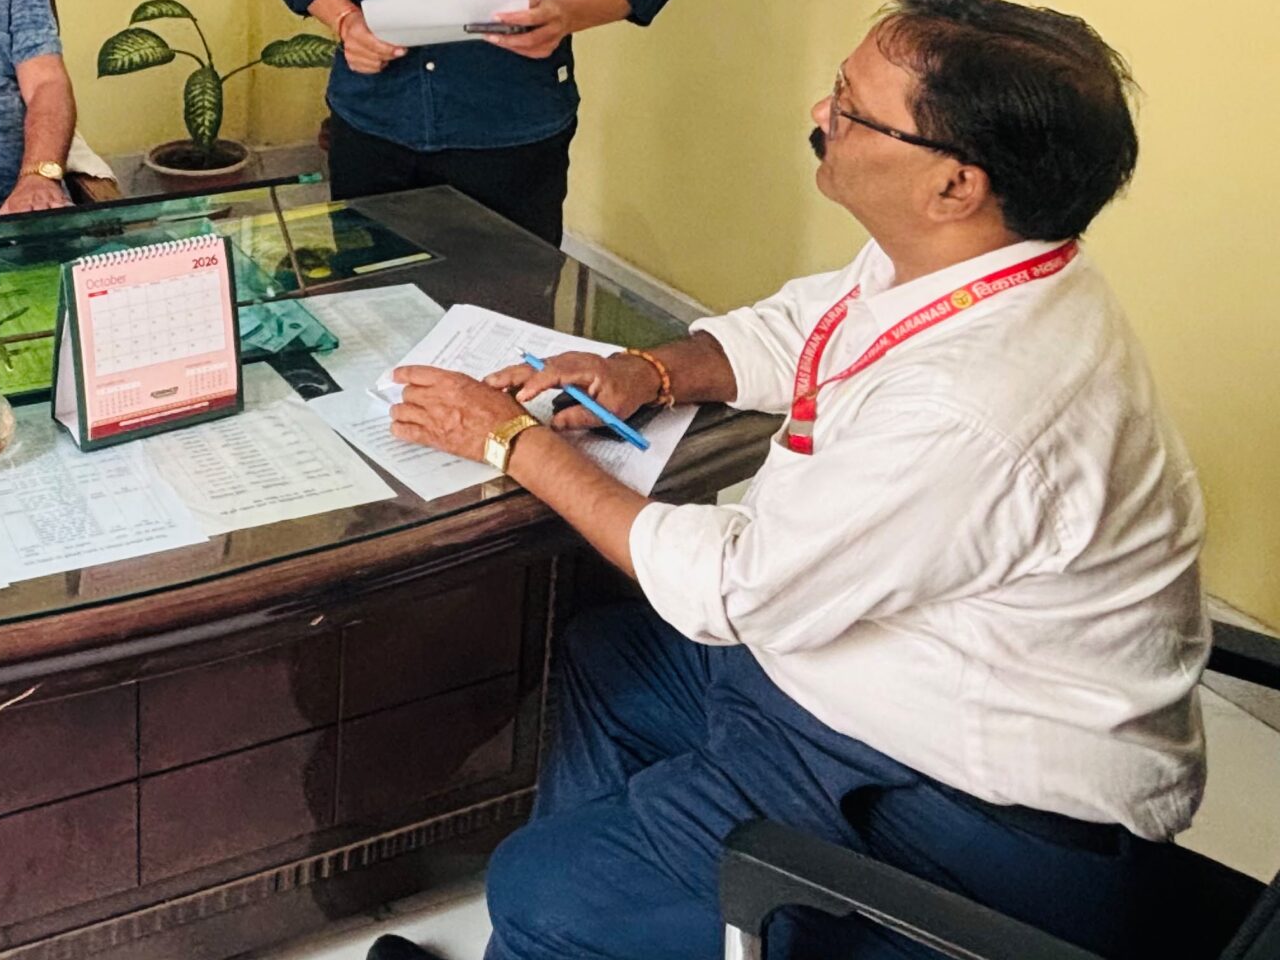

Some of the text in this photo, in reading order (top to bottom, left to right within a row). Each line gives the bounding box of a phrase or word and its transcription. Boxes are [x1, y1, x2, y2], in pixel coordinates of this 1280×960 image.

[192, 254, 219, 270] 2026
[86, 275, 126, 290] October
[971, 270, 1030, 299] विकास
[891, 300, 952, 338] VARANASI
